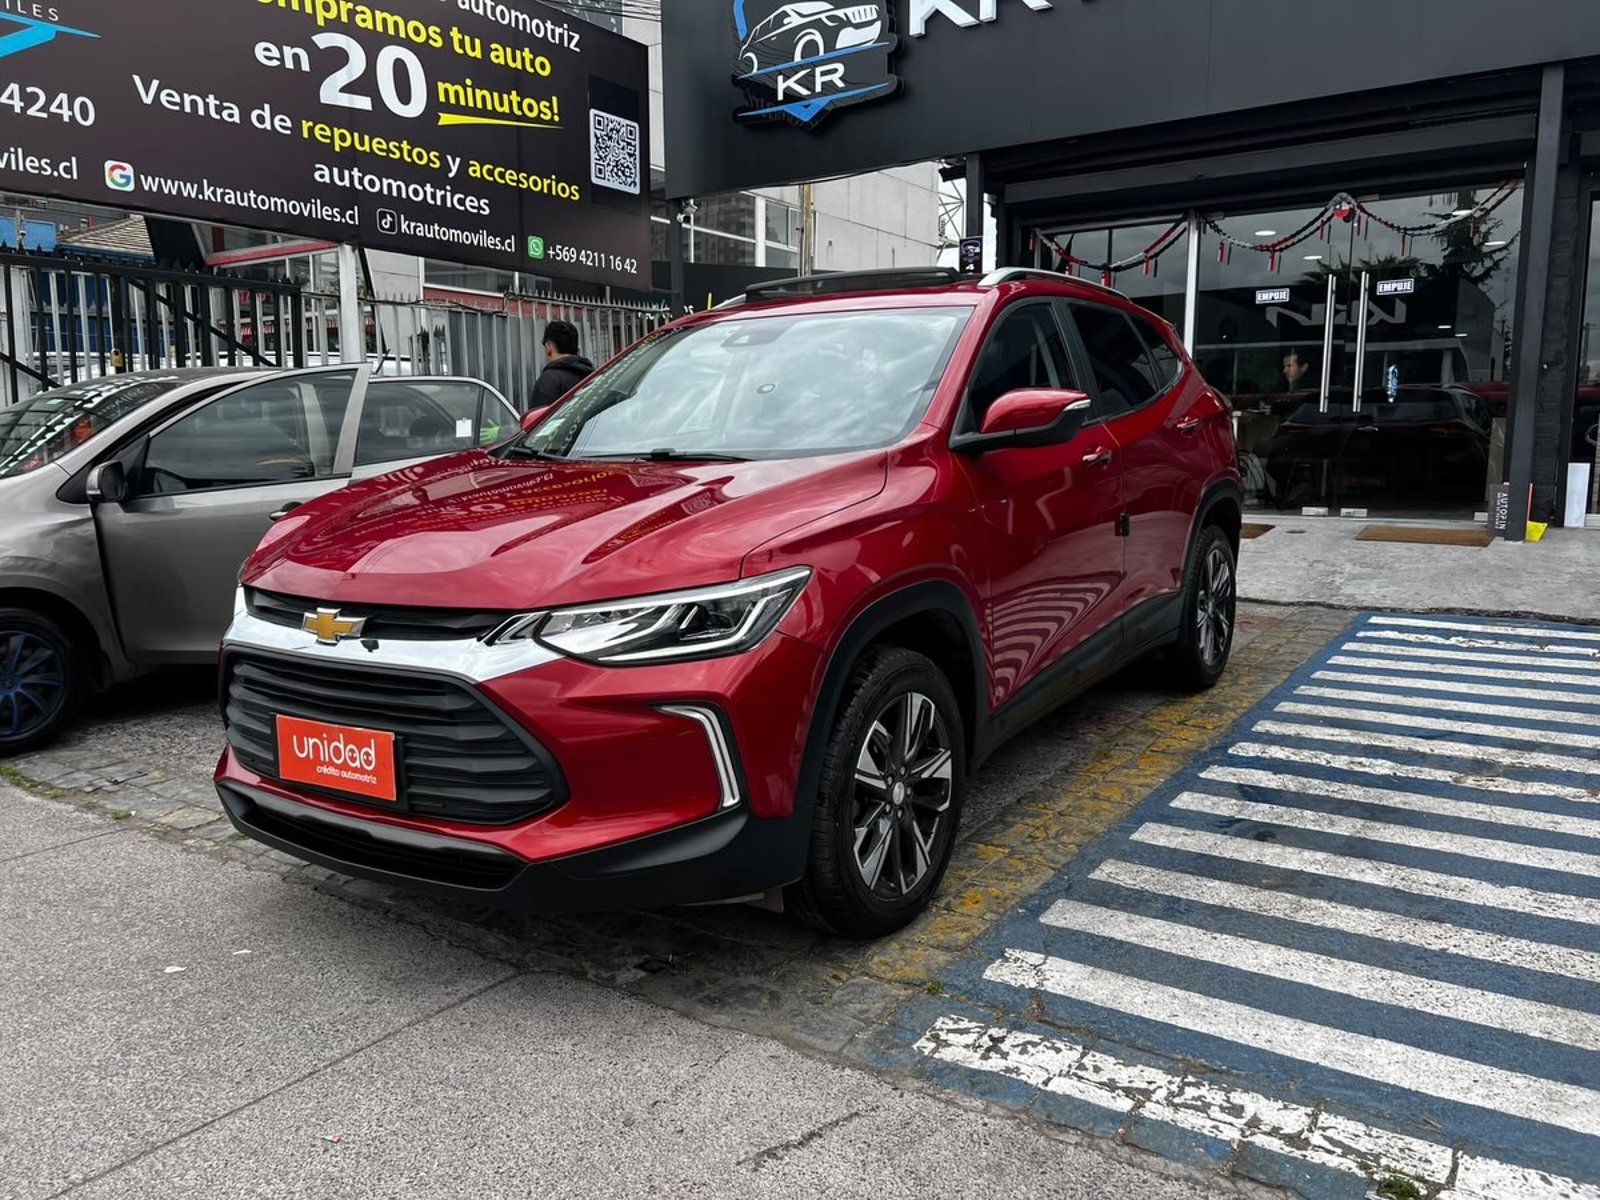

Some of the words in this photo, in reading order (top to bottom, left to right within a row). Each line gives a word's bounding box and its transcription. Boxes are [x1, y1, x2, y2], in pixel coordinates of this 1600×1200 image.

[450, 27, 482, 59] tu
[490, 43, 551, 77] auto
[254, 41, 311, 72] en
[311, 32, 427, 118] 20
[776, 63, 845, 101] KR
[437, 78, 560, 121] minutos!
[132, 74, 241, 124] Venta
[250, 103, 293, 135] de
[301, 119, 441, 169] repuestos
[447, 154, 461, 178] y
[468, 160, 581, 201] accesorios
[140, 174, 360, 226] www.krautomoviles.cl
[313, 163, 491, 216] automotrices
[400, 215, 516, 253] krautomoviles.cl
[547, 245, 577, 263] +569
[579, 249, 605, 267] 4211
[1379, 281, 1412, 292] EMPUJE
[292, 733, 376, 771] unidad
